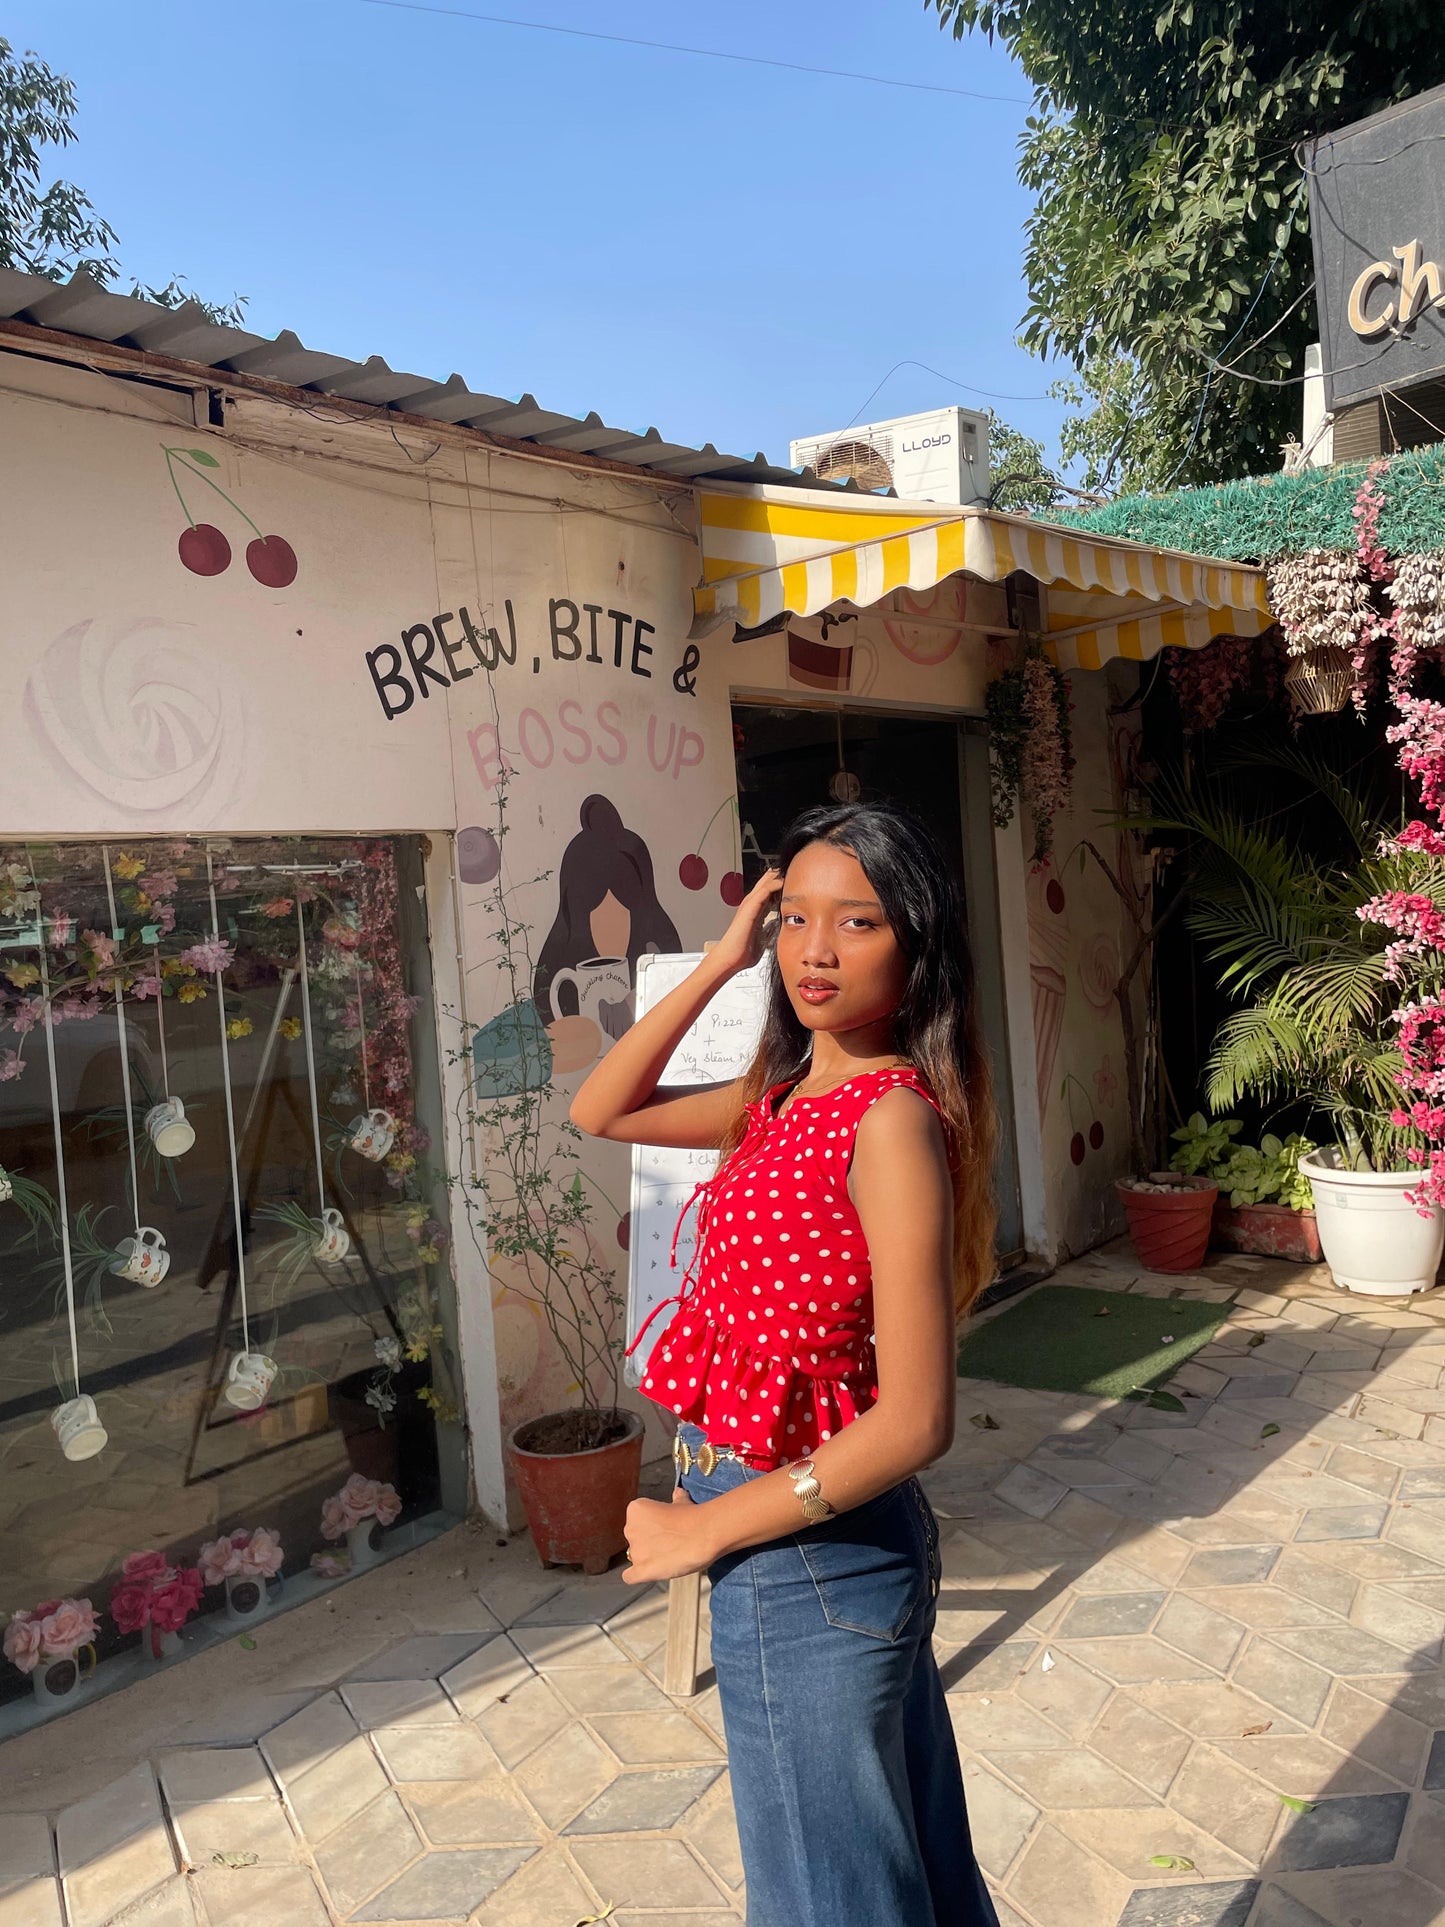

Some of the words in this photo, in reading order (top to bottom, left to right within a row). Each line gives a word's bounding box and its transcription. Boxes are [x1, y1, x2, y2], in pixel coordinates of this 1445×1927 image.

[902, 434, 952, 453] LLOYD
[549, 598, 656, 679] BITE
[672, 644, 701, 697] &
[466, 700, 628, 790] BOSS
[646, 714, 705, 780] UP
[680, 1052, 697, 1074] Veg
